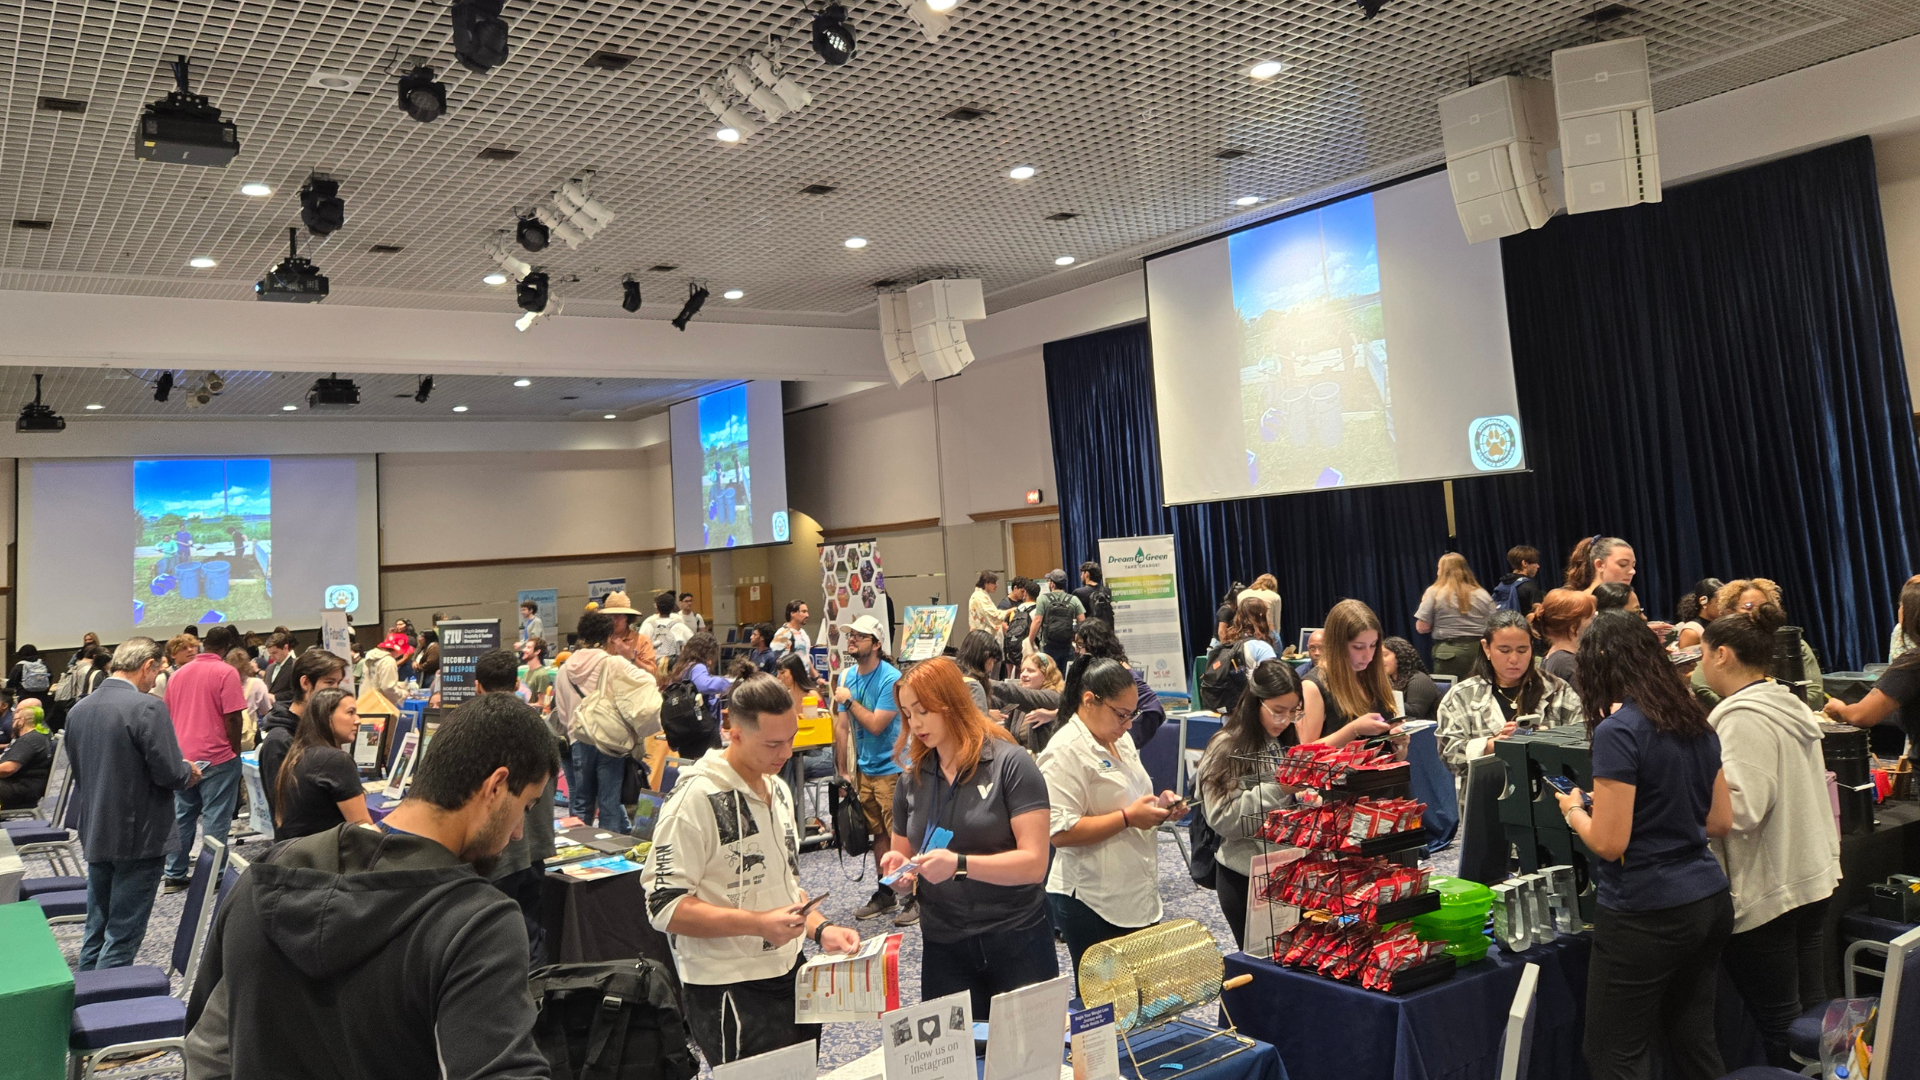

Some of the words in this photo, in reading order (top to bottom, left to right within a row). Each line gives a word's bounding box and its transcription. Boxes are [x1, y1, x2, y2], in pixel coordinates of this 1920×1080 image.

[1108, 555, 1133, 563] Dream
[444, 629, 462, 644] FIU
[443, 656, 465, 664] BECOME
[467, 656, 471, 664] A
[904, 1049, 933, 1065] Follow
[936, 1046, 945, 1055] us
[947, 1042, 959, 1051] on
[910, 1055, 955, 1075] Instagram
